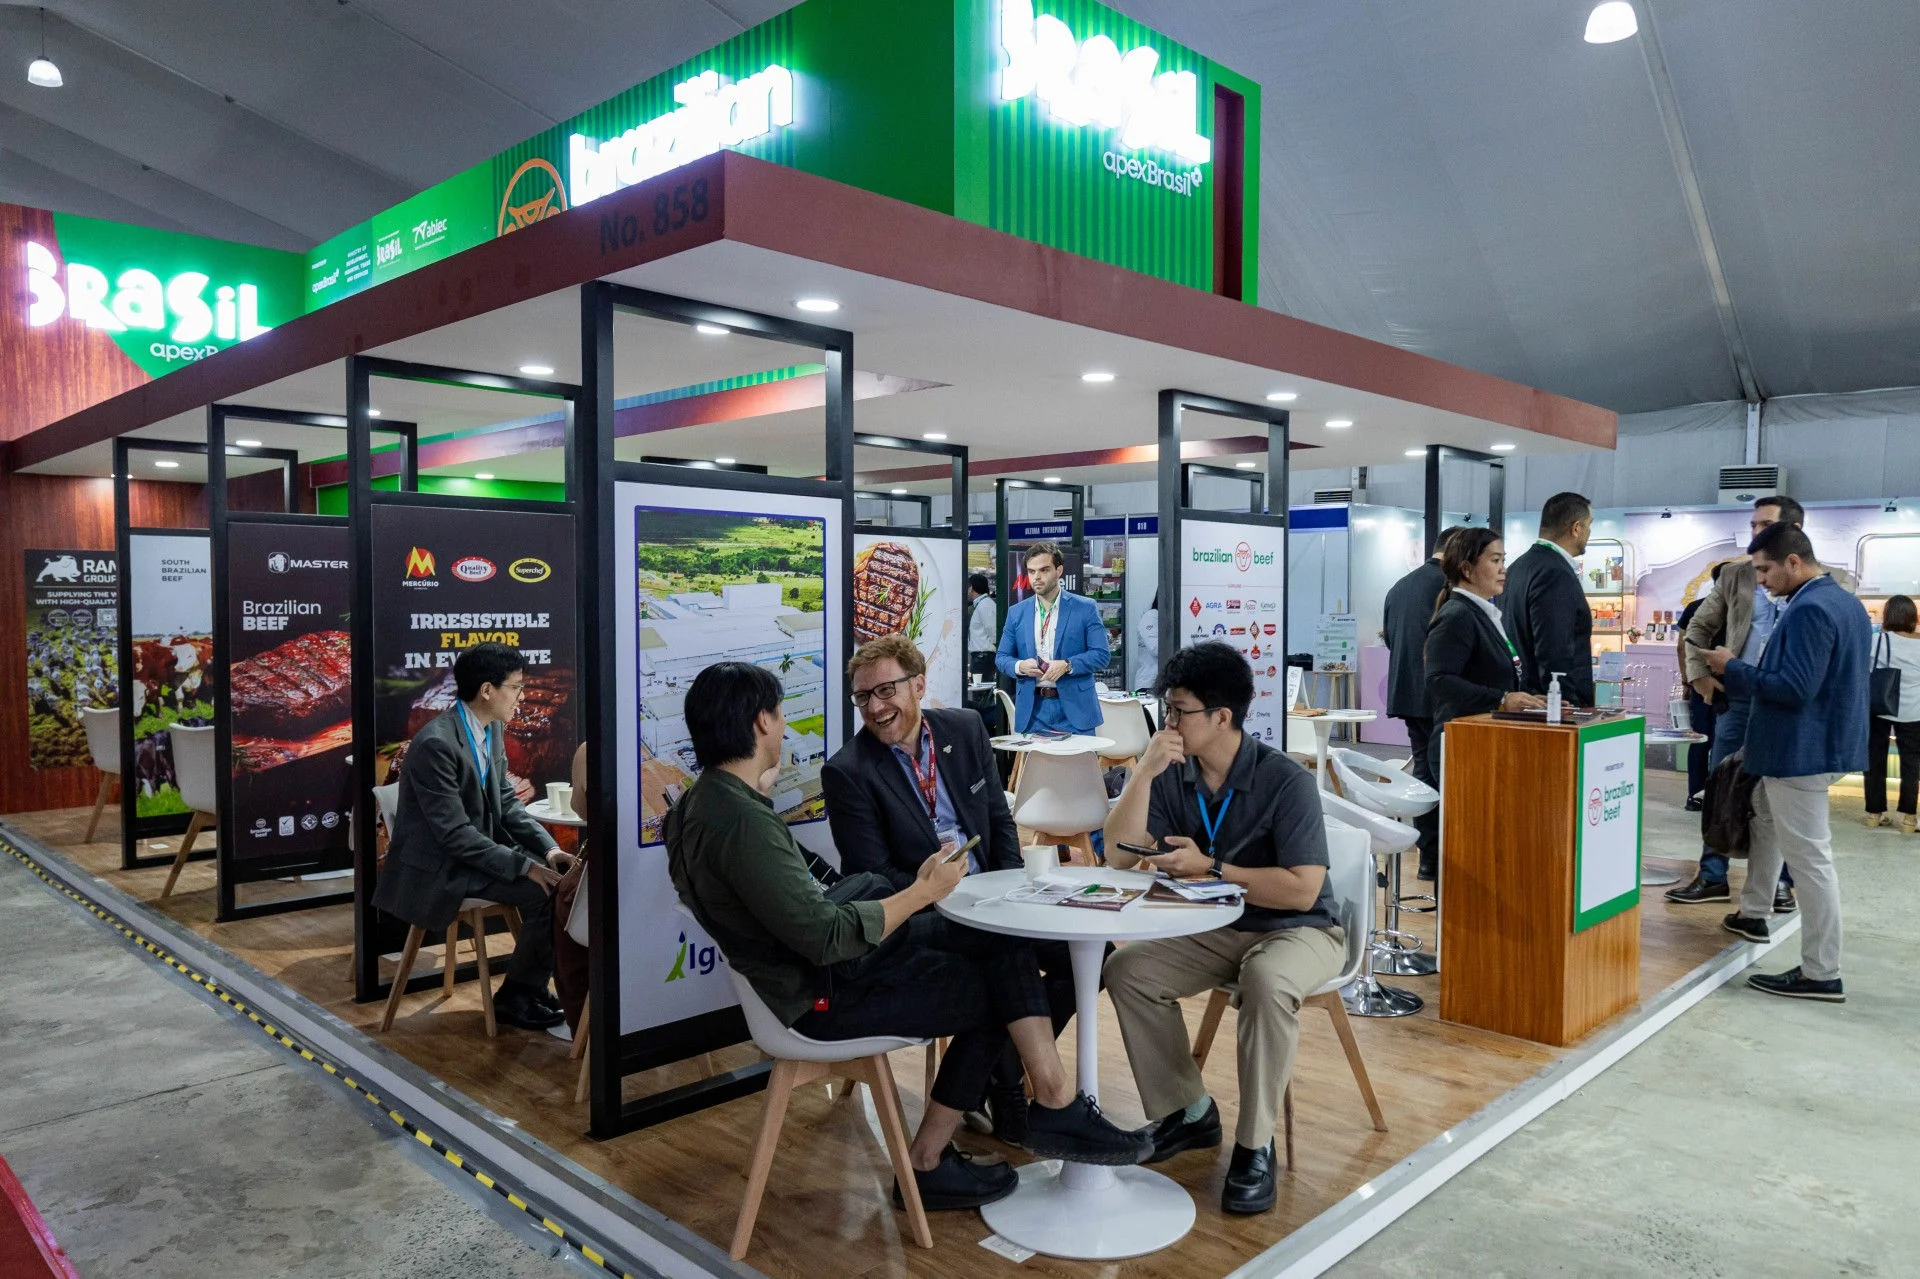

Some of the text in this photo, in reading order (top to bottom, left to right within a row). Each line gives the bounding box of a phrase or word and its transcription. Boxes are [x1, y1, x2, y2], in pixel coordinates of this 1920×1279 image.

[1103, 151, 1192, 197] apexBrasil
[601, 178, 709, 254] No. 858
[1193, 548, 1274, 564] brazilian beef
[290, 560, 349, 569] MASTER
[460, 564, 489, 573] Quality
[402, 579, 440, 587] MERCÚRIO
[243, 600, 322, 615] Brazilian
[243, 616, 289, 631] BEEF
[410, 613, 550, 629] IRRESISTIBLE
[404, 652, 431, 668] IN
[1604, 781, 1634, 802] brazilian
[1604, 801, 1620, 821] beef
